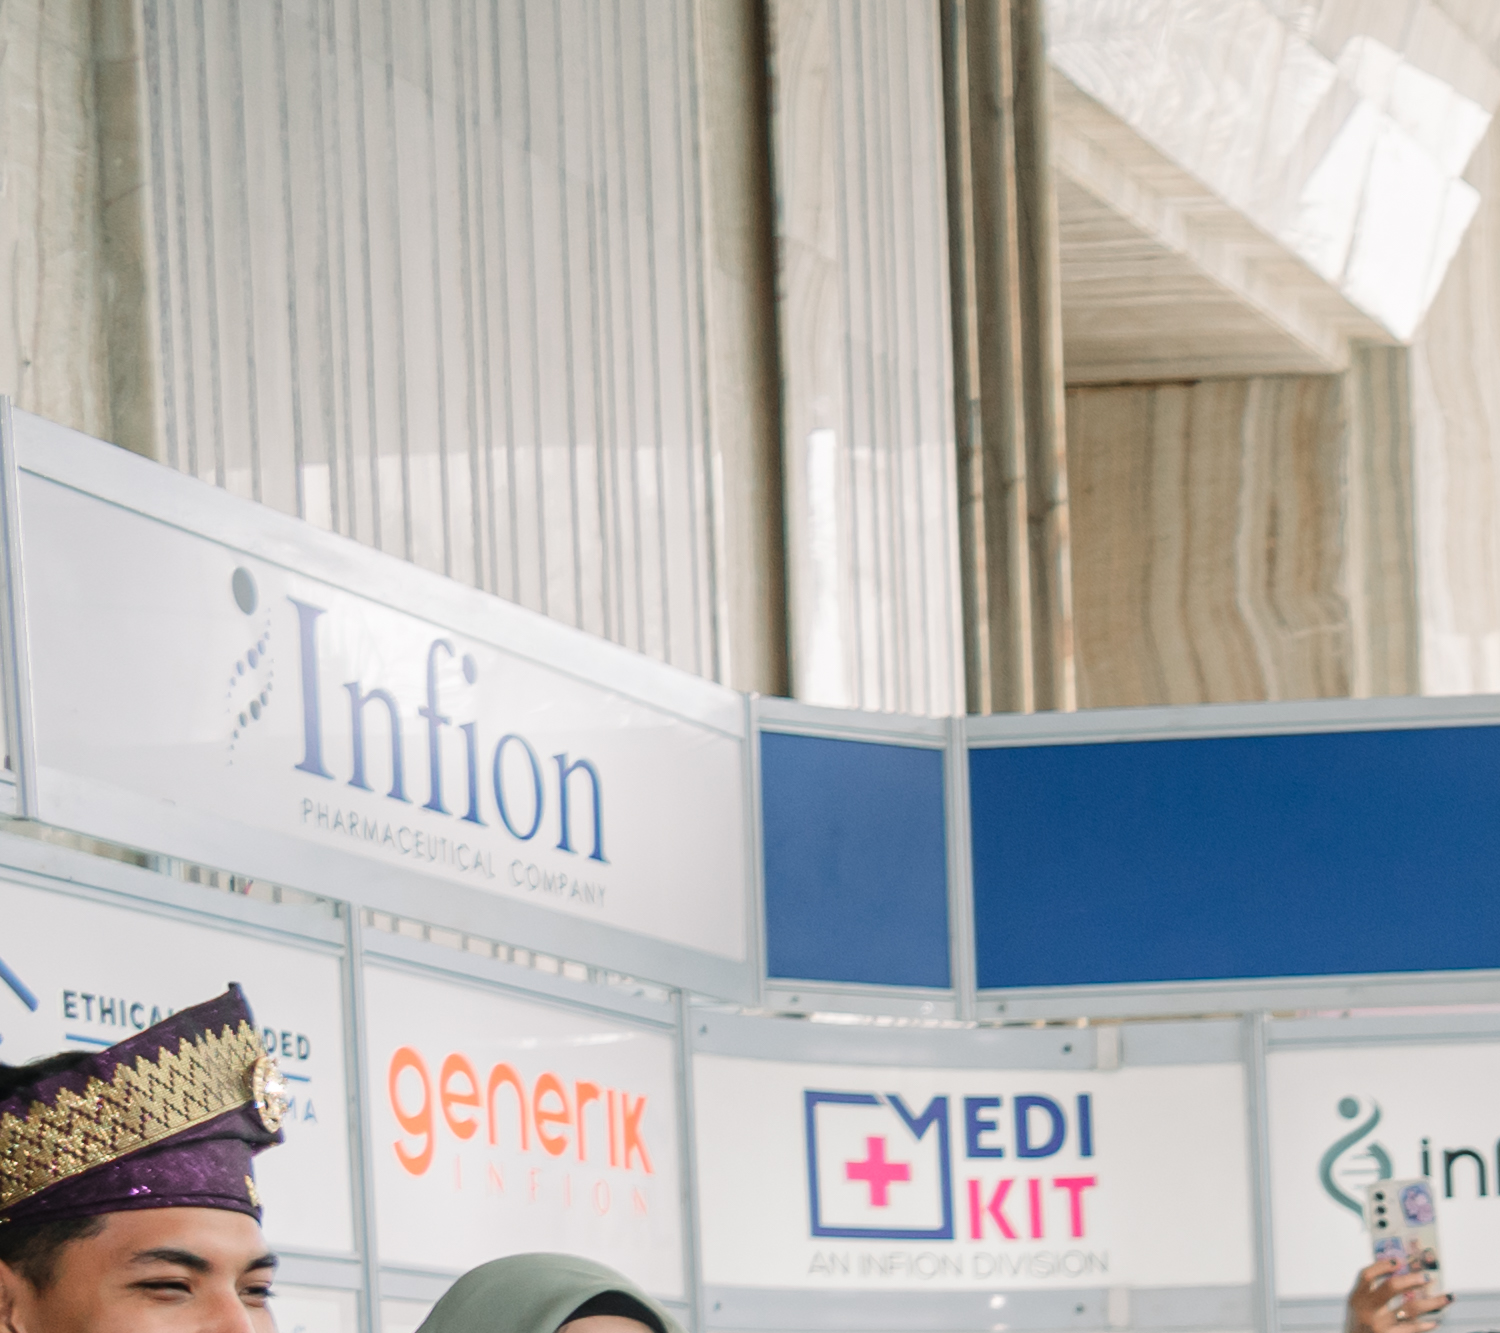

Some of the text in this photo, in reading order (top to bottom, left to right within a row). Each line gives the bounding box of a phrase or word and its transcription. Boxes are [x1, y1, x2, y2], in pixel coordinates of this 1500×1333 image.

[286, 596, 611, 865] Infion
[300, 797, 607, 908] PHARMACEUTICAL COMPANY
[62, 988, 311, 1061] ETHICA DED
[456, 1154, 648, 1217] INFION
[967, 1177, 1098, 1240] KIT
[807, 1249, 1110, 1281] AN INFION DIVISION
